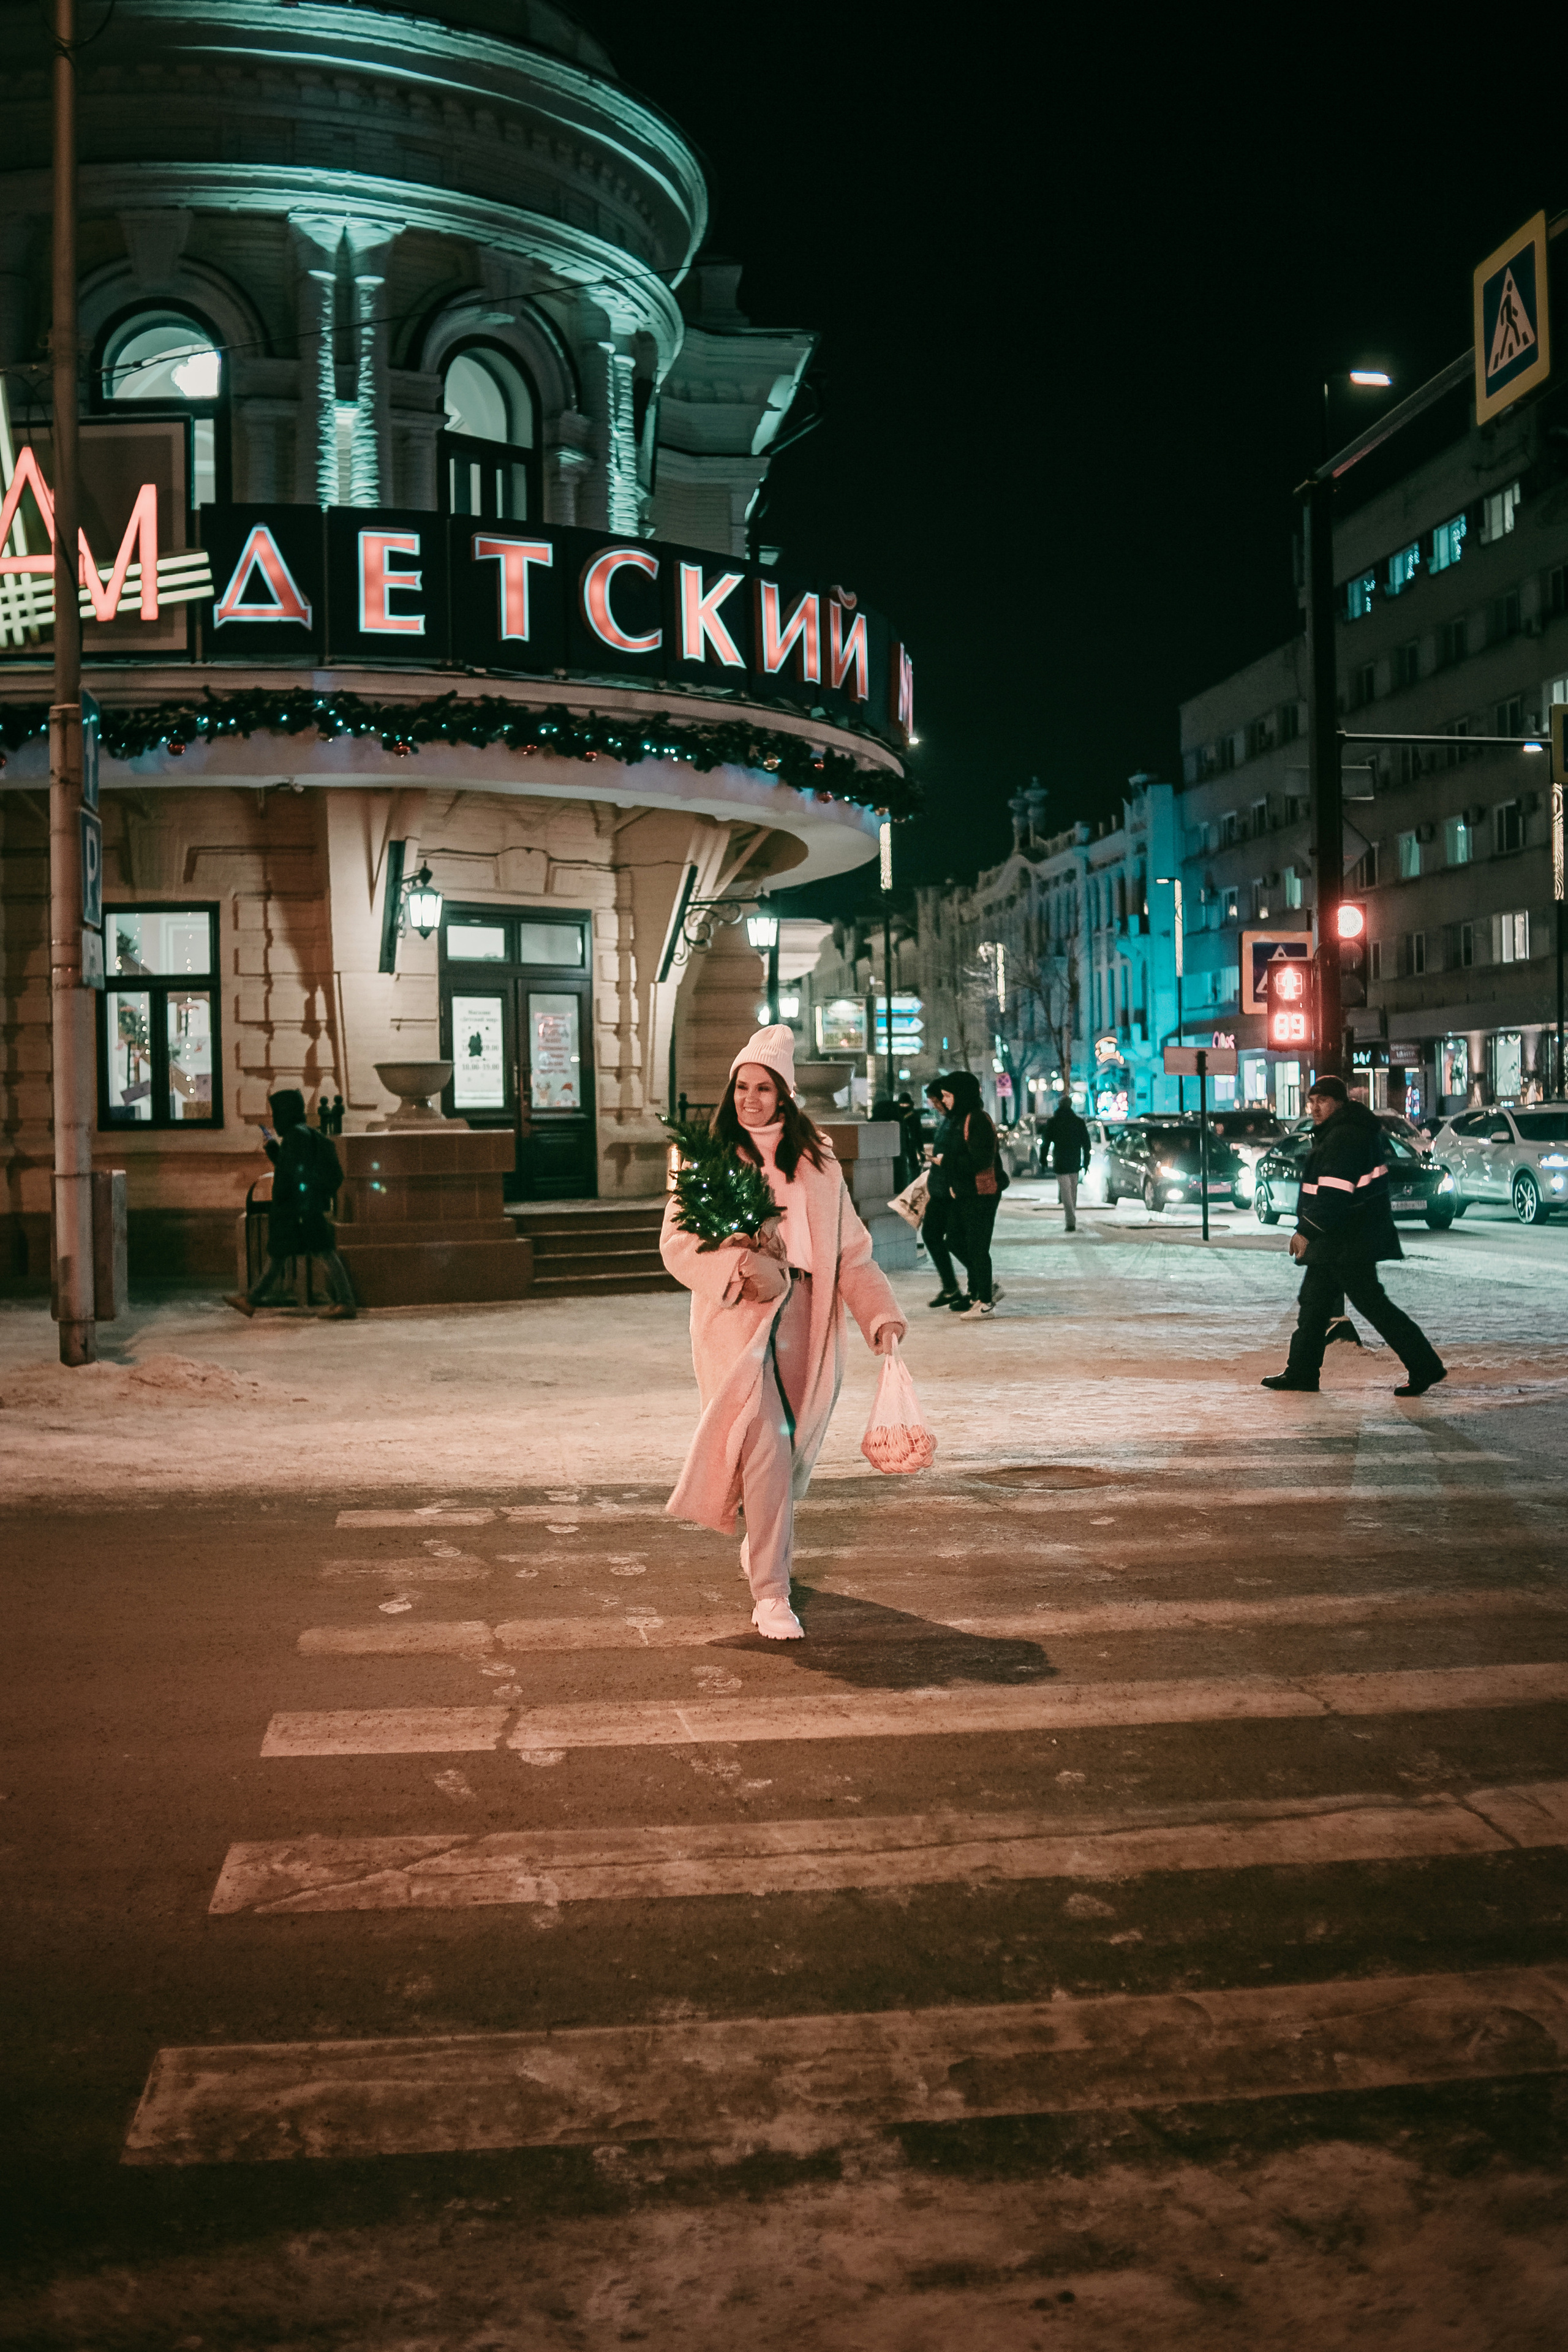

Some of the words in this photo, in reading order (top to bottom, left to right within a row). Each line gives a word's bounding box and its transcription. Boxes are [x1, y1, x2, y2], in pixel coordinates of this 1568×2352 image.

[213, 522, 869, 703] ДЕТСКИЙ
[86, 825, 97, 911] P
[1275, 1013, 1304, 1039] 89
